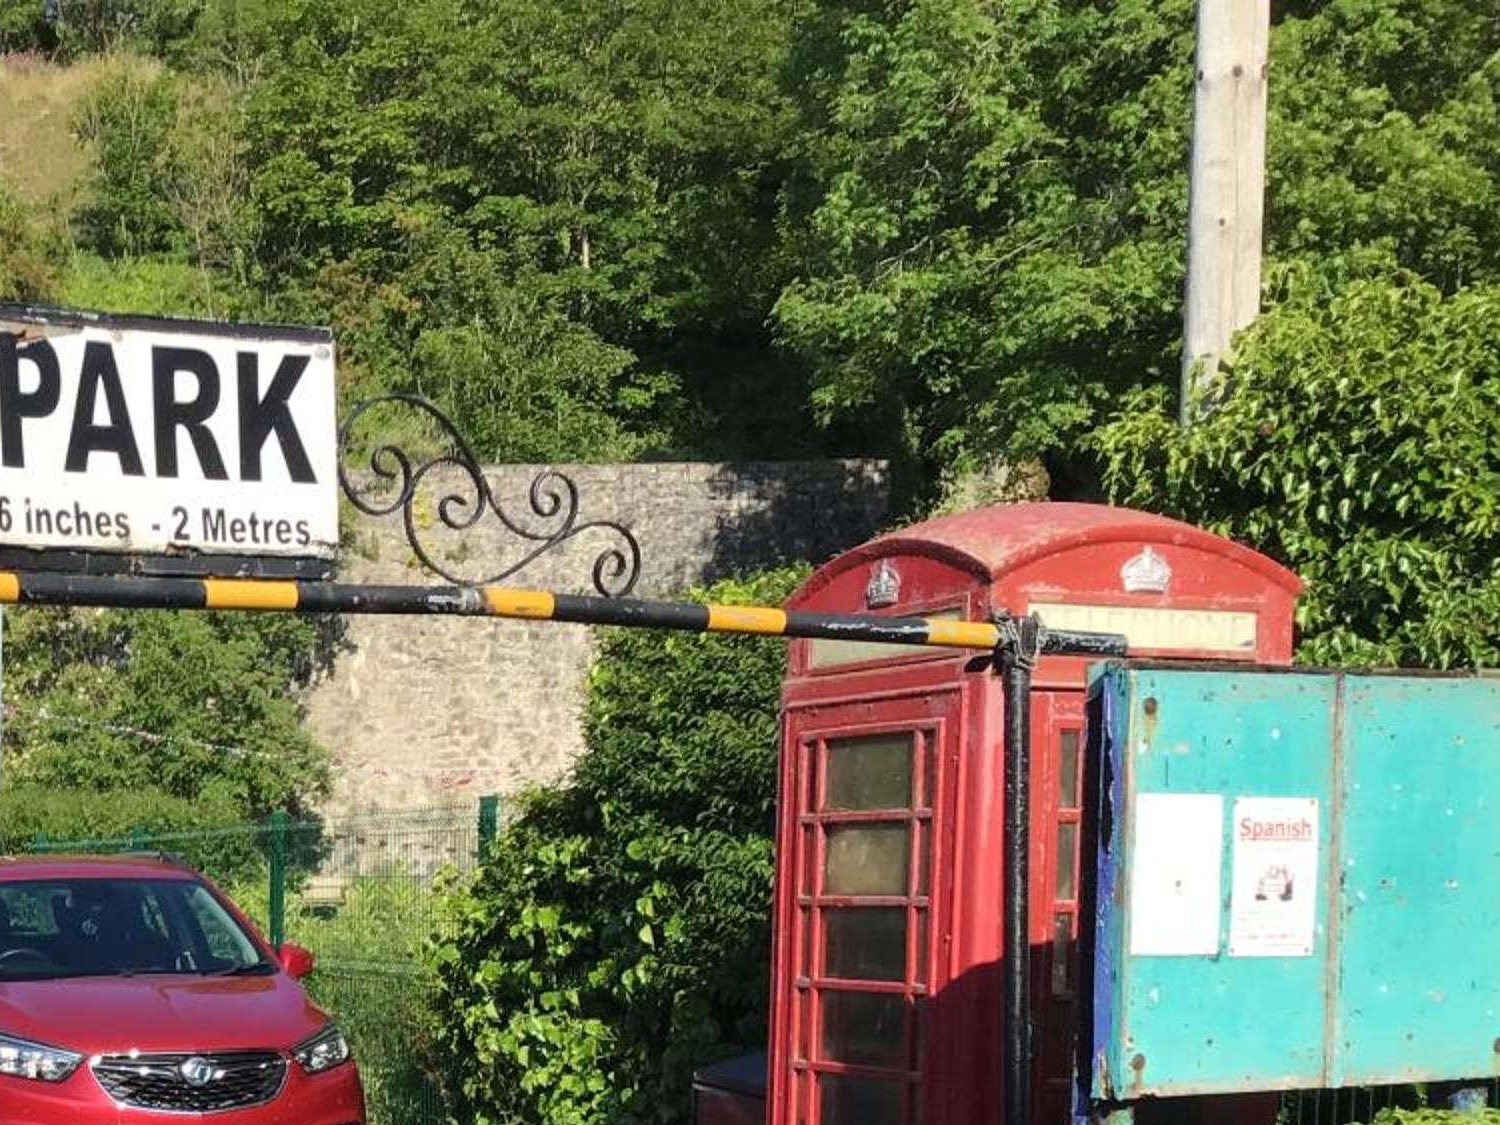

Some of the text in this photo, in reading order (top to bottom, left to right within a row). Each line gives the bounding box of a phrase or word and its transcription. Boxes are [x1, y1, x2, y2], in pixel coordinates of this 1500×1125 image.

[24, 497, 132, 539] inches
[172, 506, 191, 541] 2
[202, 507, 312, 545] Metres
[1240, 817, 1312, 841] Spanish
